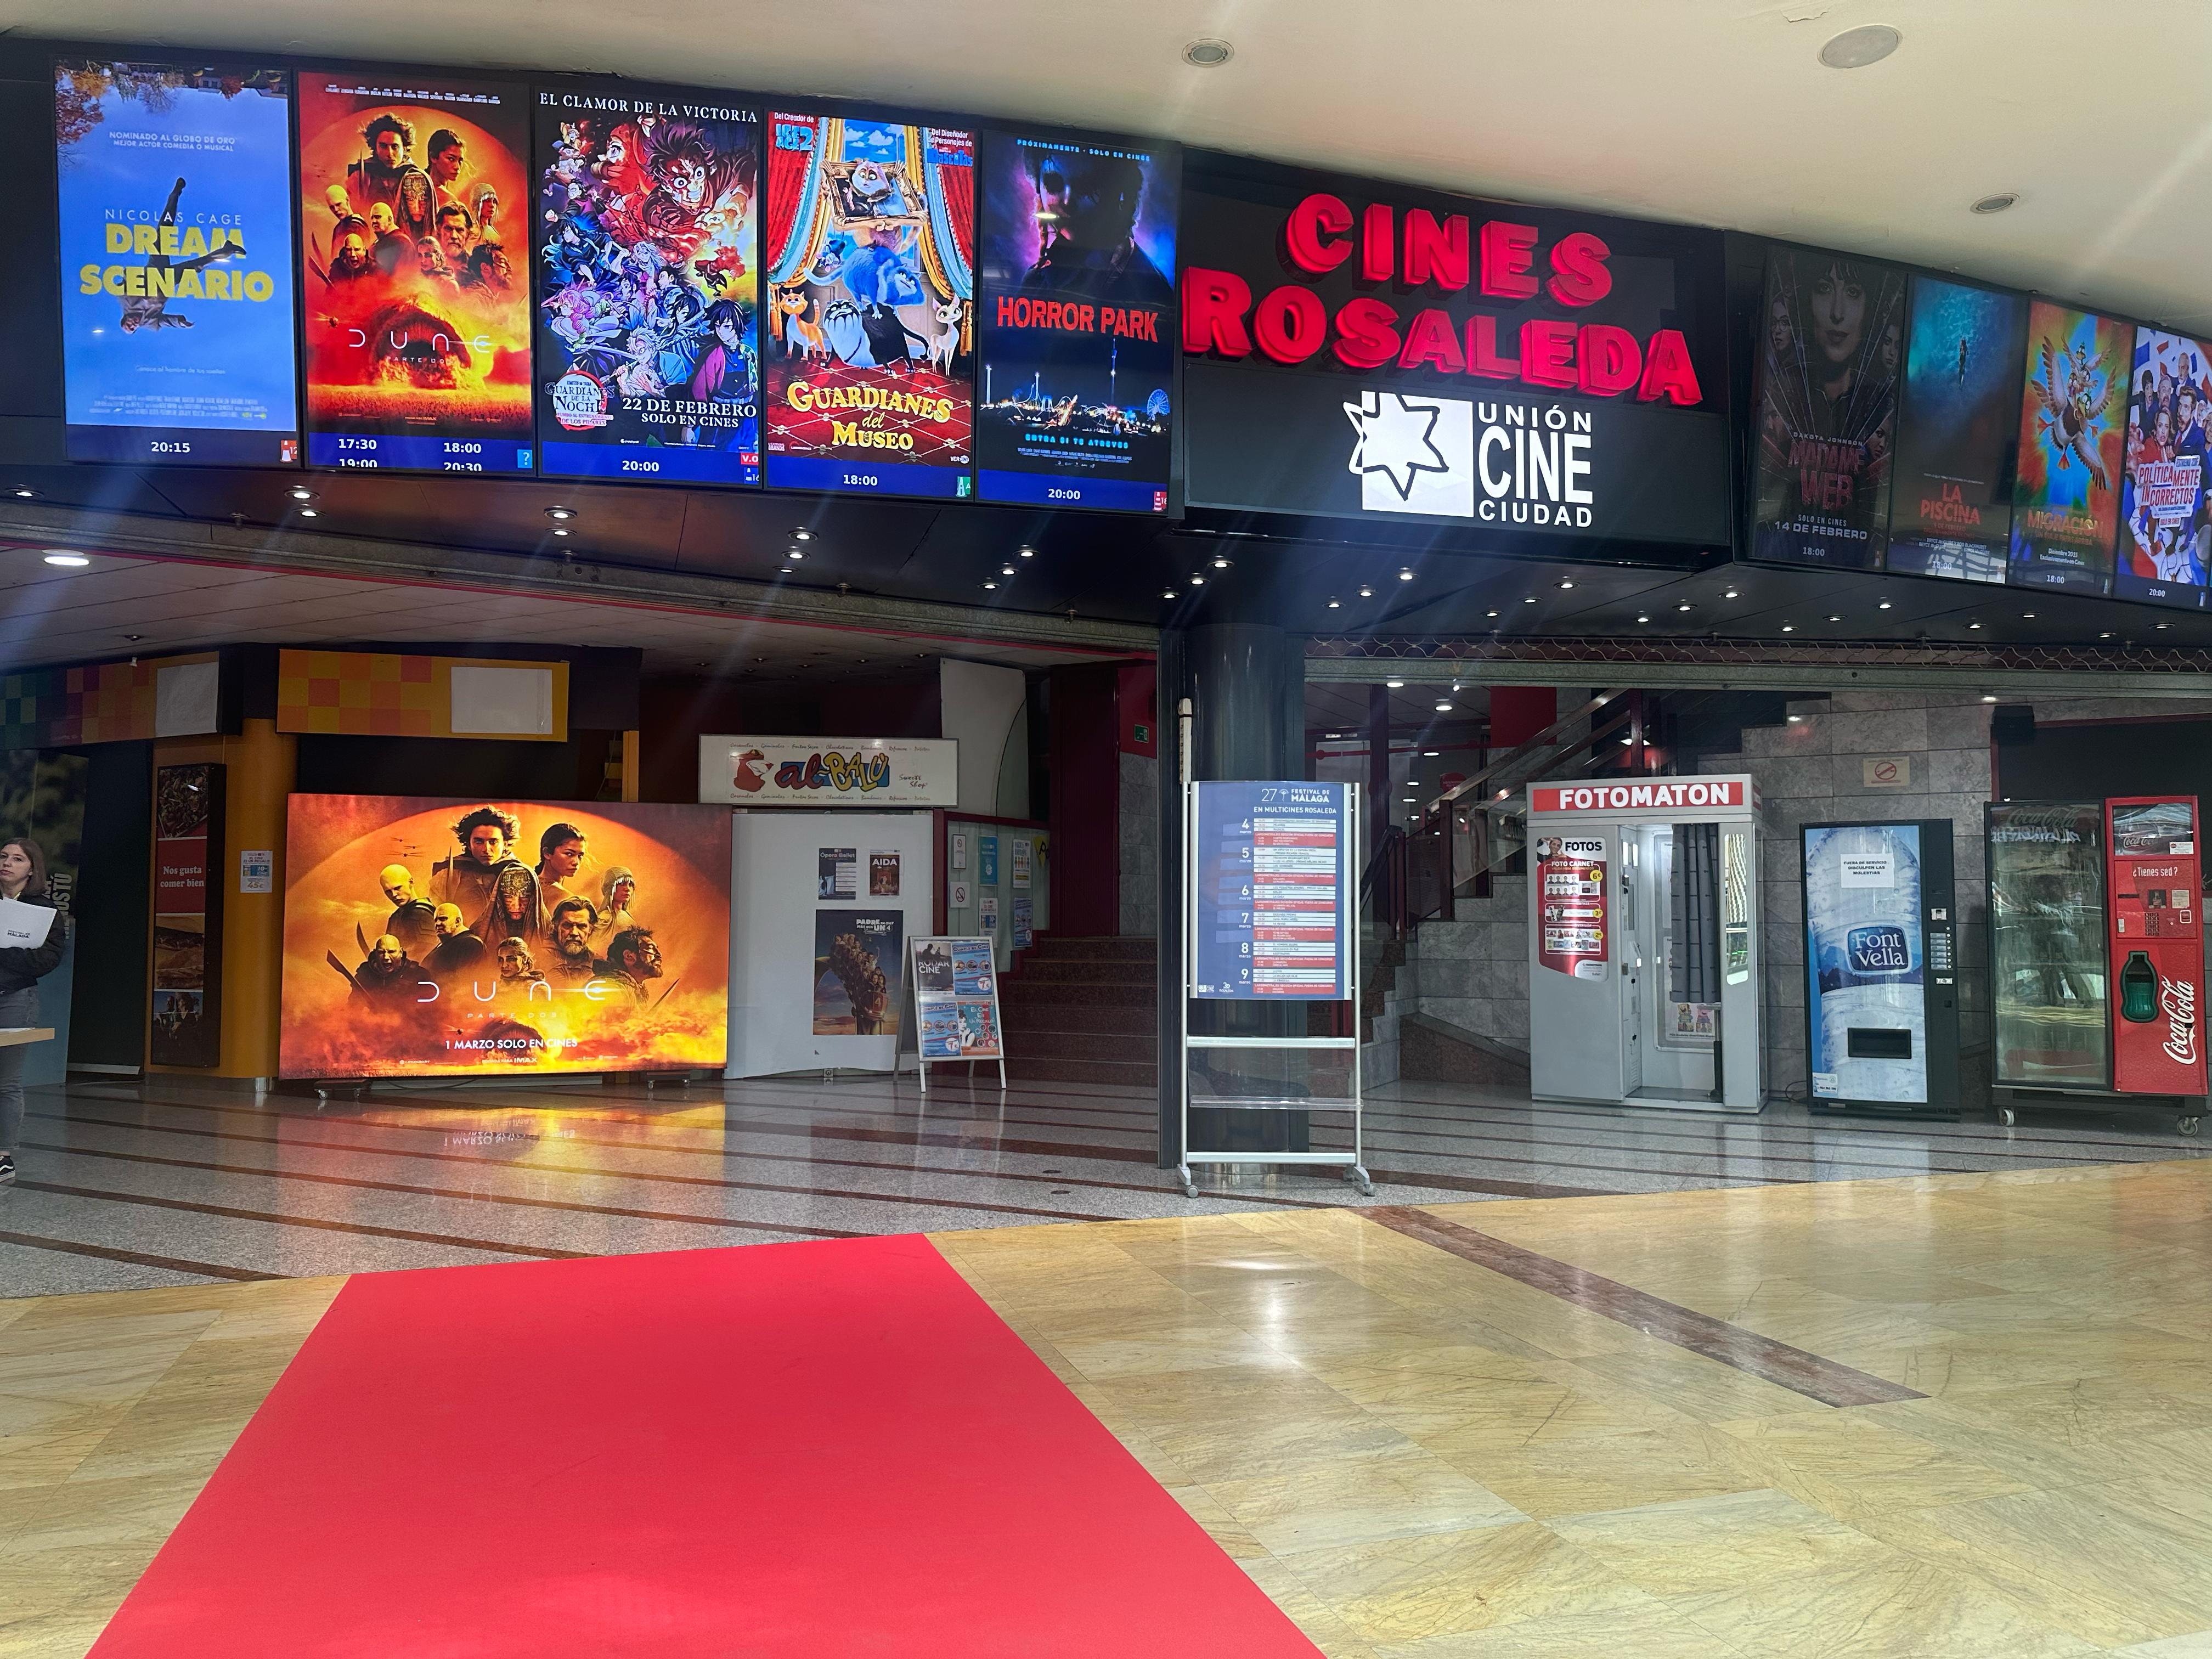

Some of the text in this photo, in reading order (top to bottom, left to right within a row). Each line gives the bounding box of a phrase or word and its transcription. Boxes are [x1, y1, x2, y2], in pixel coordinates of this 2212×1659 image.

[540, 93, 758, 123] EL CLAMOR DE LA VICTORIA
[774, 112, 783, 120] Del
[784, 113, 806, 122] Creador
[109, 132, 158, 140] NOMINADO
[173, 134, 201, 143] GLOBO
[776, 123, 800, 138] ICE
[776, 126, 813, 151] AGE 2
[941, 129, 968, 139] Diseñador
[935, 137, 964, 147] Personajes
[1017, 139, 1080, 153] PRÓXIMAMENTE
[1089, 148, 1110, 156] SOLO
[1127, 153, 1150, 162] CINES
[105, 209, 241, 225] NICOLAS CAGE
[106, 223, 246, 258] DREAM
[1281, 193, 1613, 308] CINES
[80, 264, 274, 302] SCENARIO
[997, 295, 1159, 343] HORROR PARK
[348, 329, 490, 353] DUNE
[1182, 265, 1703, 407] ROSALEDA
[555, 396, 606, 413] NOCHE
[622, 398, 757, 417] 22 DE FEBRERO
[787, 381, 953, 424] GUARDIANES
[641, 413, 738, 428] SOLO EN CINES
[862, 410, 885, 429] del
[1479, 402, 1592, 433] UNIÓN
[831, 421, 914, 450] MUSEO
[1793, 432, 1864, 446] DAKOTA JOHNSON
[151, 442, 190, 453] 20:15
[338, 438, 482, 454] 17:30 18:00
[338, 459, 377, 468] 19:00
[1479, 425, 1593, 504] CINE
[1787, 440, 1865, 474] MADAME
[622, 460, 659, 472] 20:00
[843, 475, 878, 486] 18:00
[2138, 464, 2200, 487] POLÍTICAMENTE
[1048, 488, 1081, 500] 20:00
[1801, 469, 1854, 510] WEB
[1942, 483, 1962, 504] LA
[2141, 486, 2194, 506] INCORRECTOS
[1479, 500, 1592, 528] CIUDAD
[1798, 514, 1815, 523] SOLO
[1827, 517, 1847, 527] CINES
[1920, 499, 1982, 526] PISCINA
[1775, 521, 1867, 540] 14 DE FEBRERO
[2027, 510, 2103, 538] MIGRACIÓN
[1802, 546, 1825, 556] 18:00
[1932, 561, 1952, 570] 18:00
[2046, 574, 2064, 584] 18:00
[2149, 588, 2165, 597] 20:00
[1261, 788, 1278, 802] 27
[1291, 793, 1330, 803] MÁLAGA
[1560, 783, 1730, 810] FOTOMATON
[1242, 818, 1250, 830] 4
[1242, 847, 1250, 859] 5
[1565, 842, 1602, 851] FOTOS
[872, 858, 898, 866] AIDA
[163, 866, 202, 877] Nos gusta
[160, 879, 205, 888] comer bien
[1242, 884, 1249, 896] 6
[1242, 912, 1249, 923] 7
[1241, 942, 1249, 953] 8
[1855, 932, 1902, 951] Font
[1855, 950, 1905, 967] Vella
[919, 966, 940, 974] CINE
[1241, 968, 1249, 979] 9
[417, 980, 606, 1003] DUNE
[2161, 974, 2197, 1064] Coca-Cola
[445, 1038, 578, 1050] 1 MARZO SOLO EN CINES
